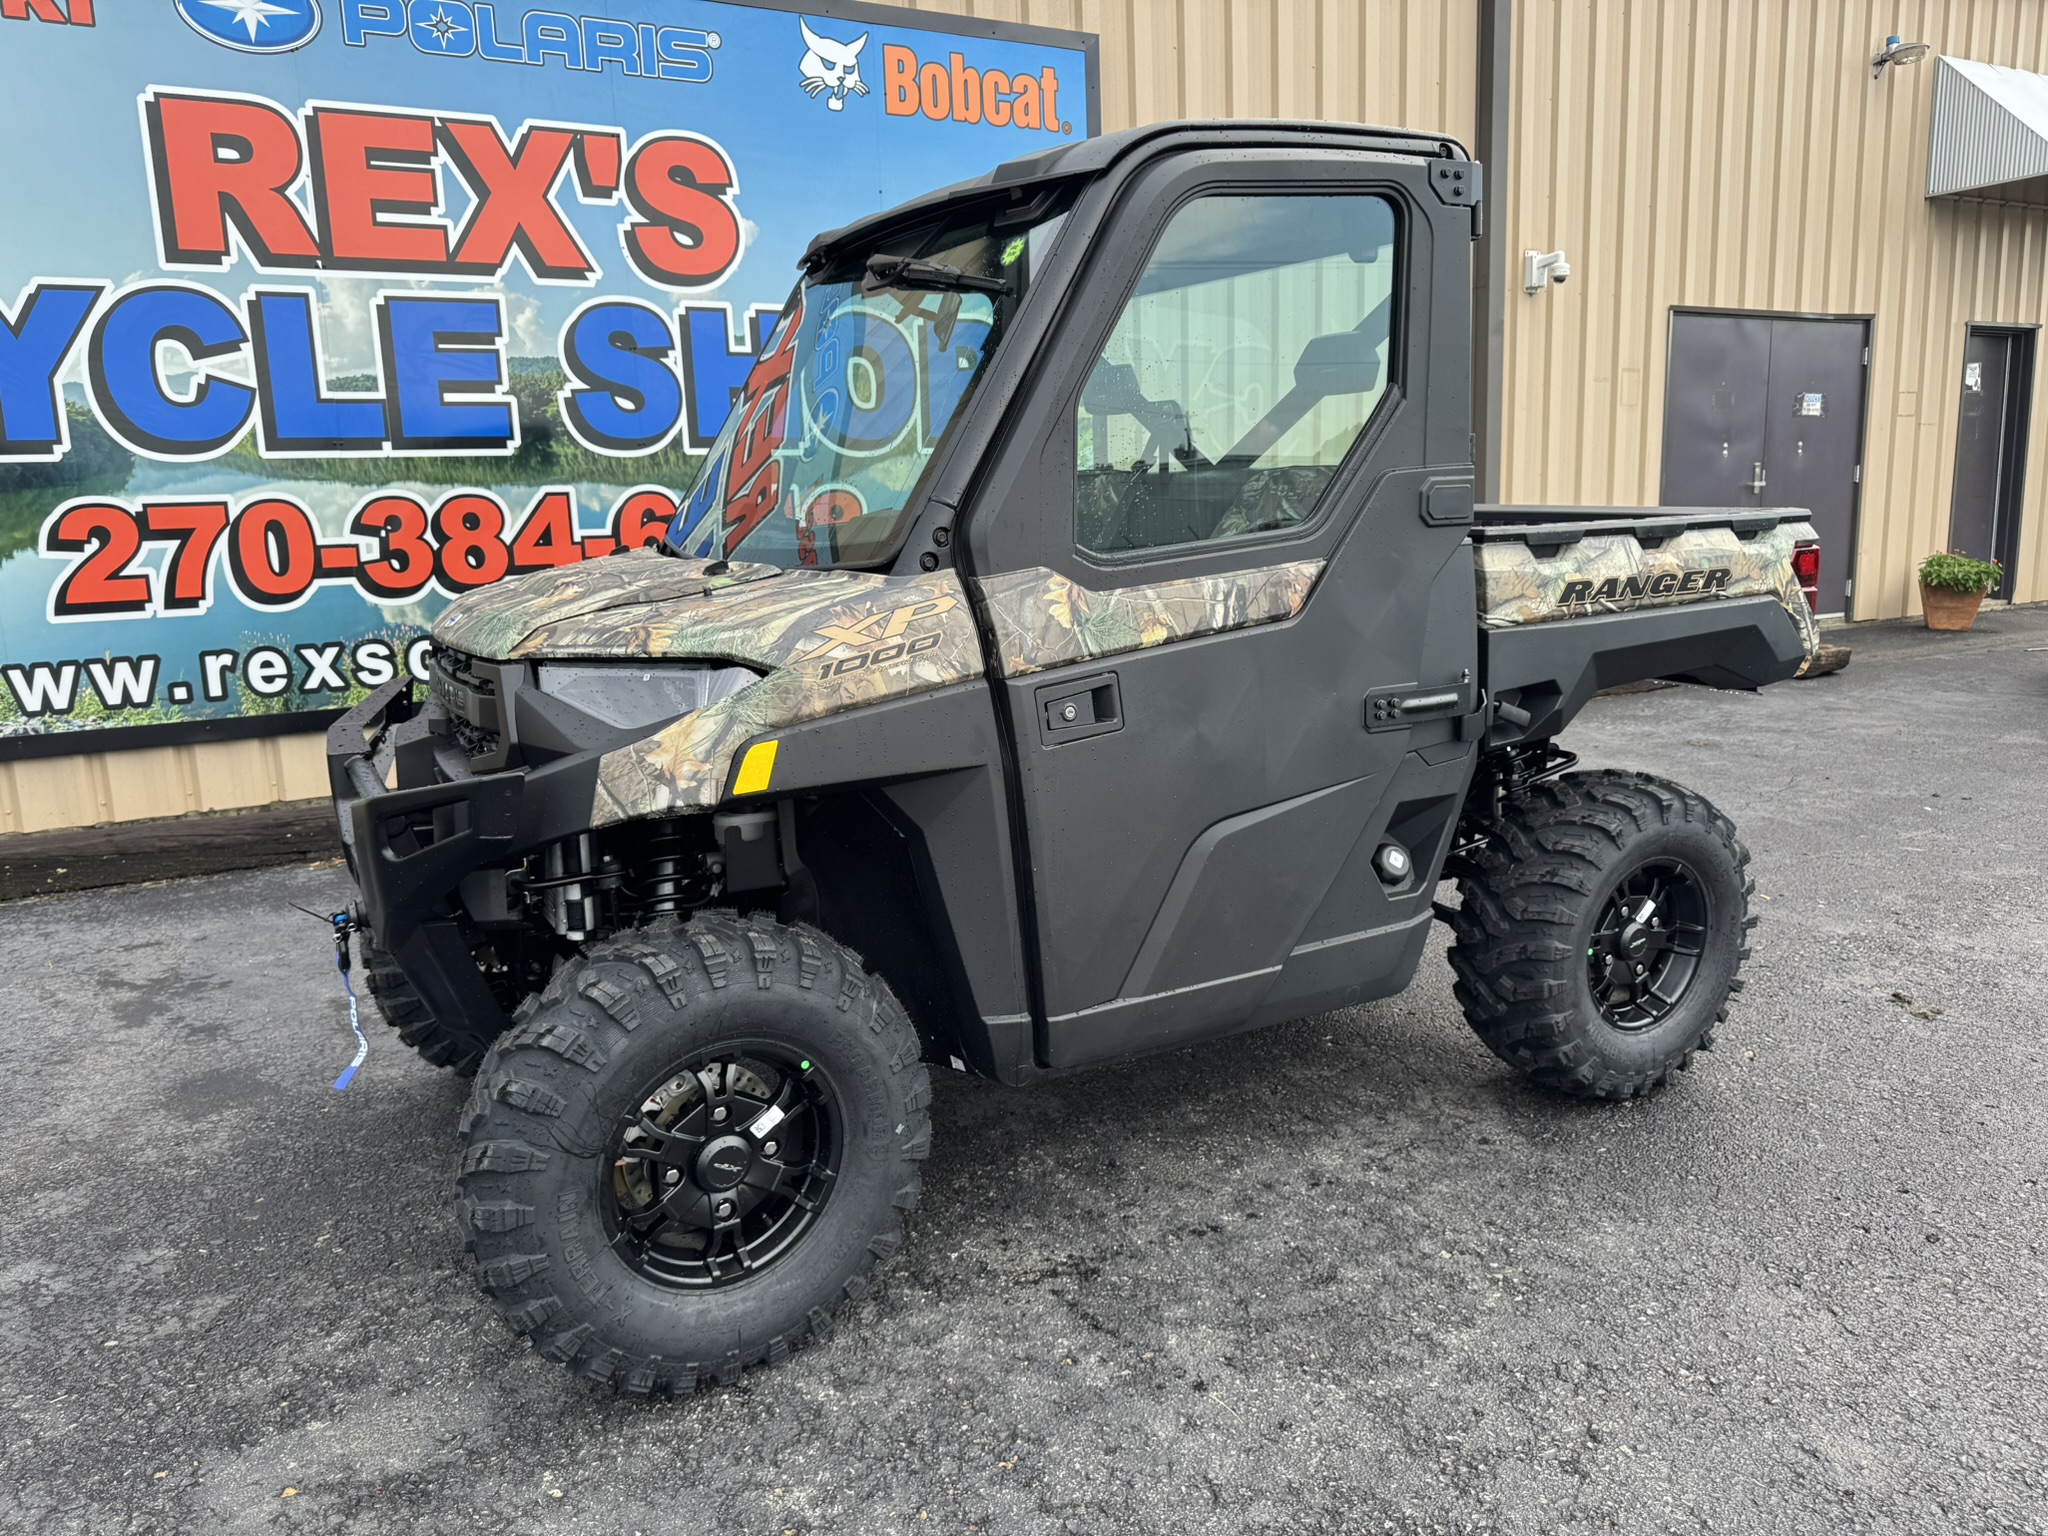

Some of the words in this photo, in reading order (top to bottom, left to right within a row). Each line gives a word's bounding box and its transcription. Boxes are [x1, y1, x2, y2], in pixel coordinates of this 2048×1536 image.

[343, 0, 714, 83] POLARIS
[882, 43, 1060, 133] Bobcat
[140, 86, 744, 291] REX'S
[40, 487, 868, 621] 270-384-6
[1556, 567, 1733, 608] RANGER
[787, 594, 960, 666] XP
[818, 631, 943, 681] 1000
